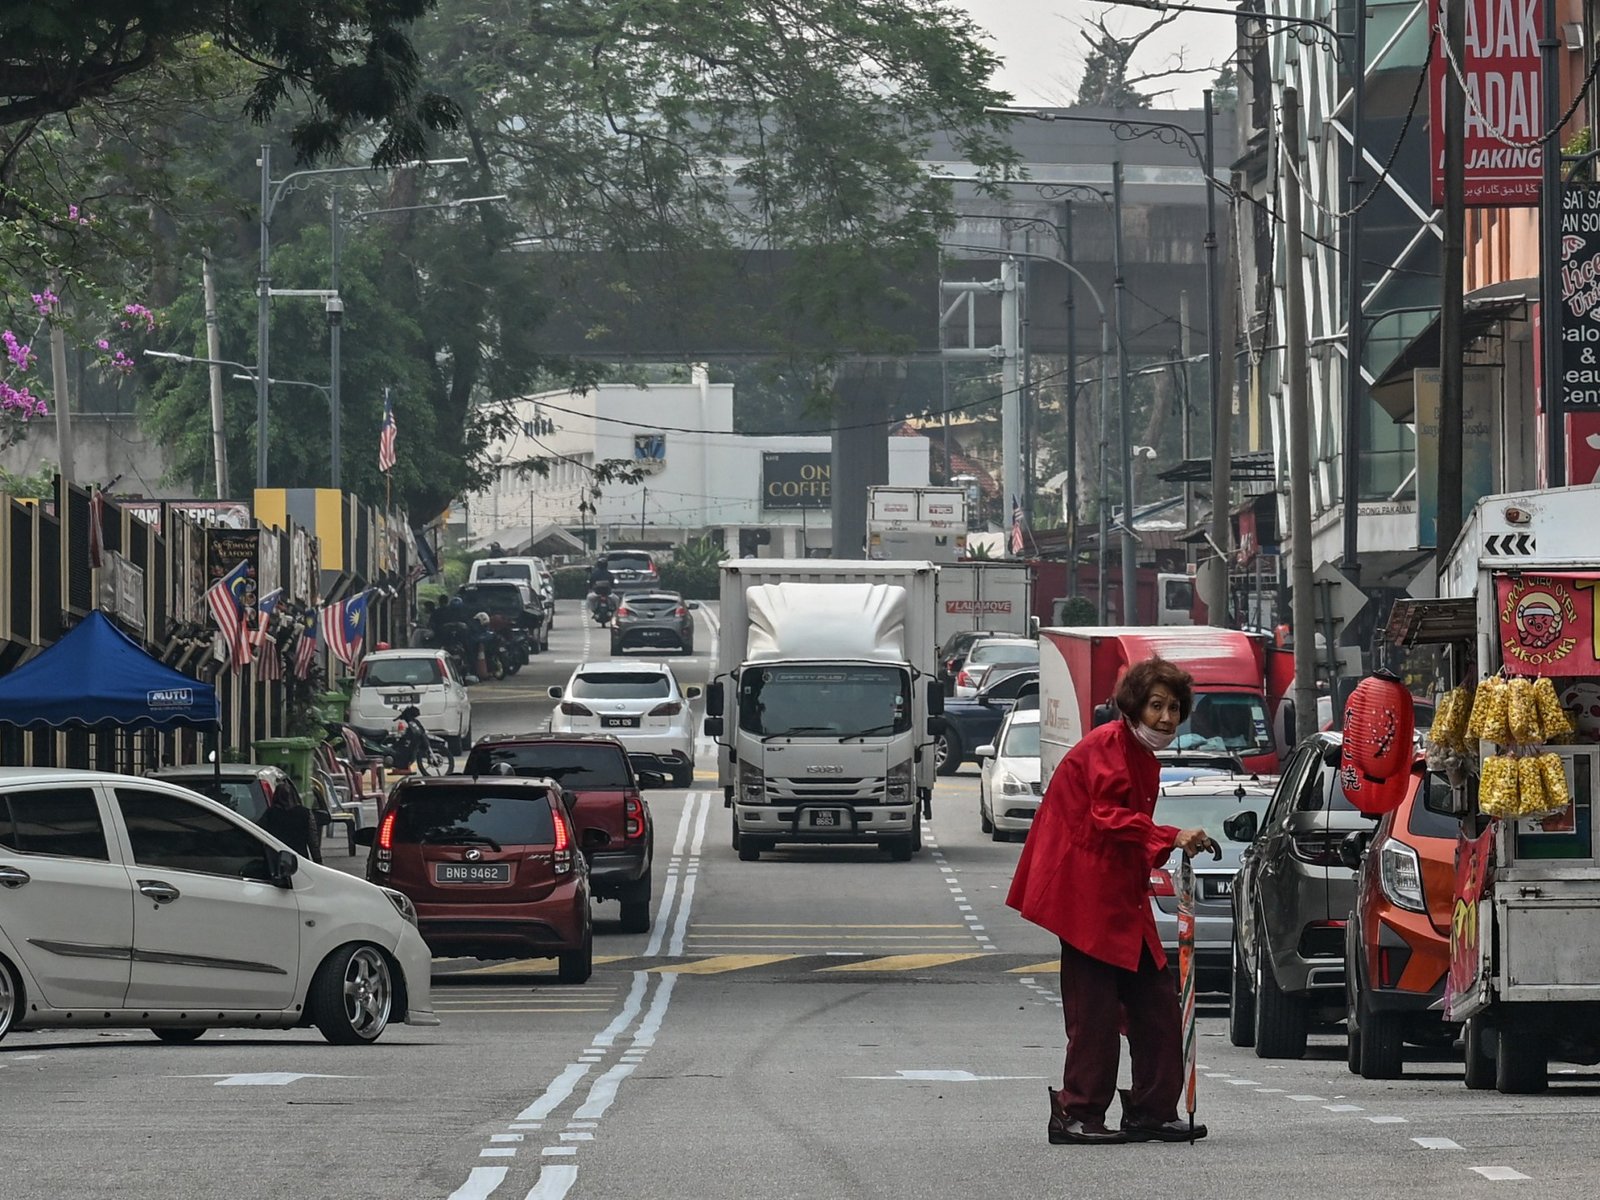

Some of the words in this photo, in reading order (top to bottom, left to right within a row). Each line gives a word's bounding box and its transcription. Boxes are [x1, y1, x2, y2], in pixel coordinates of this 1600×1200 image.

[1441, 71, 1539, 138] ADAI
[1439, 147, 1542, 169] JAKING
[1561, 213, 1579, 232] AN
[1581, 213, 1600, 232] SO
[1568, 280, 1600, 317] Uni
[1580, 347, 1597, 364] &
[956, 601, 1011, 610] LALAMOVE
[1503, 637, 1577, 665] TAKOYAKI
[807, 765, 844, 773] ISUZU
[446, 867, 468, 878] BNB
[470, 867, 498, 879] 9462
